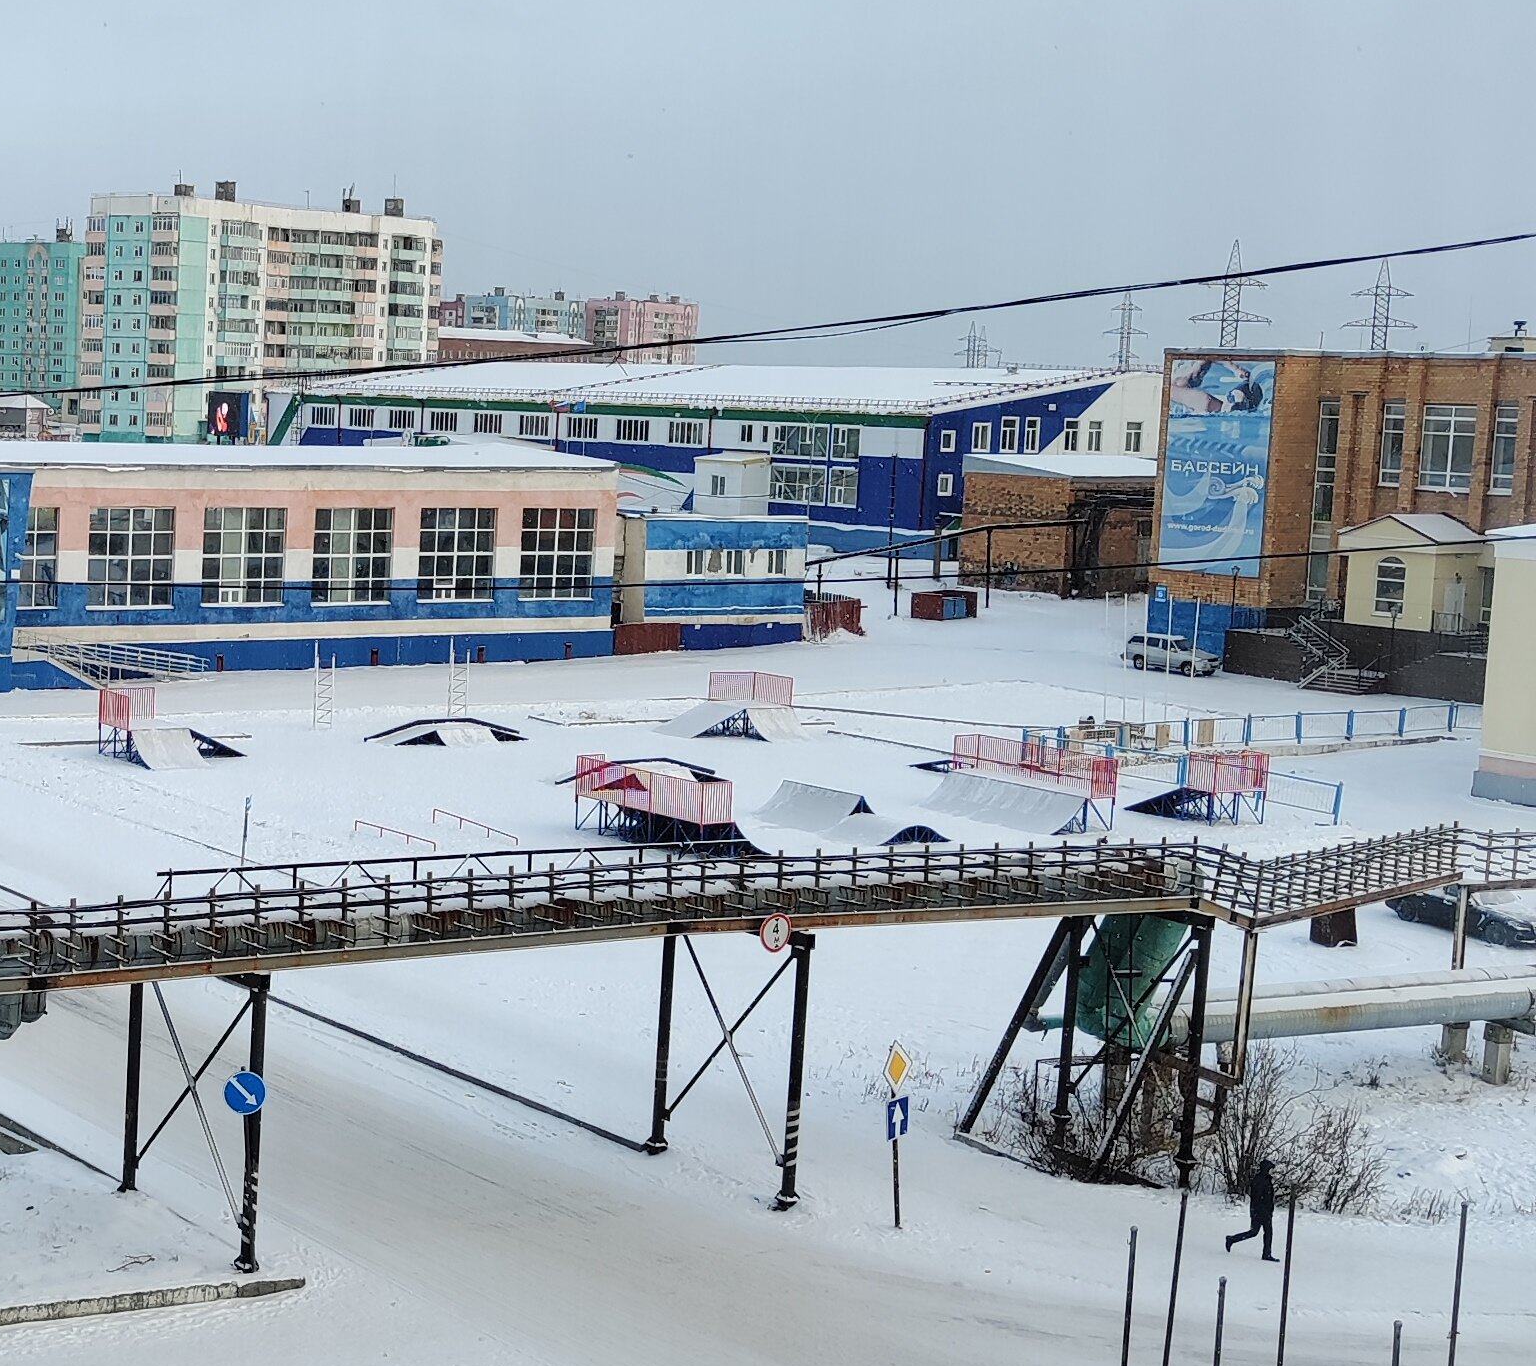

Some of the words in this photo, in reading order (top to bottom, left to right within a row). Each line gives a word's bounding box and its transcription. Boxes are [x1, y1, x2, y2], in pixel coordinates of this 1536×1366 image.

[1171, 459, 1258, 475] БАССЕЙН
[1167, 522, 1254, 535] www.gorod-dud.ru
[772, 922, 780, 935] 4
